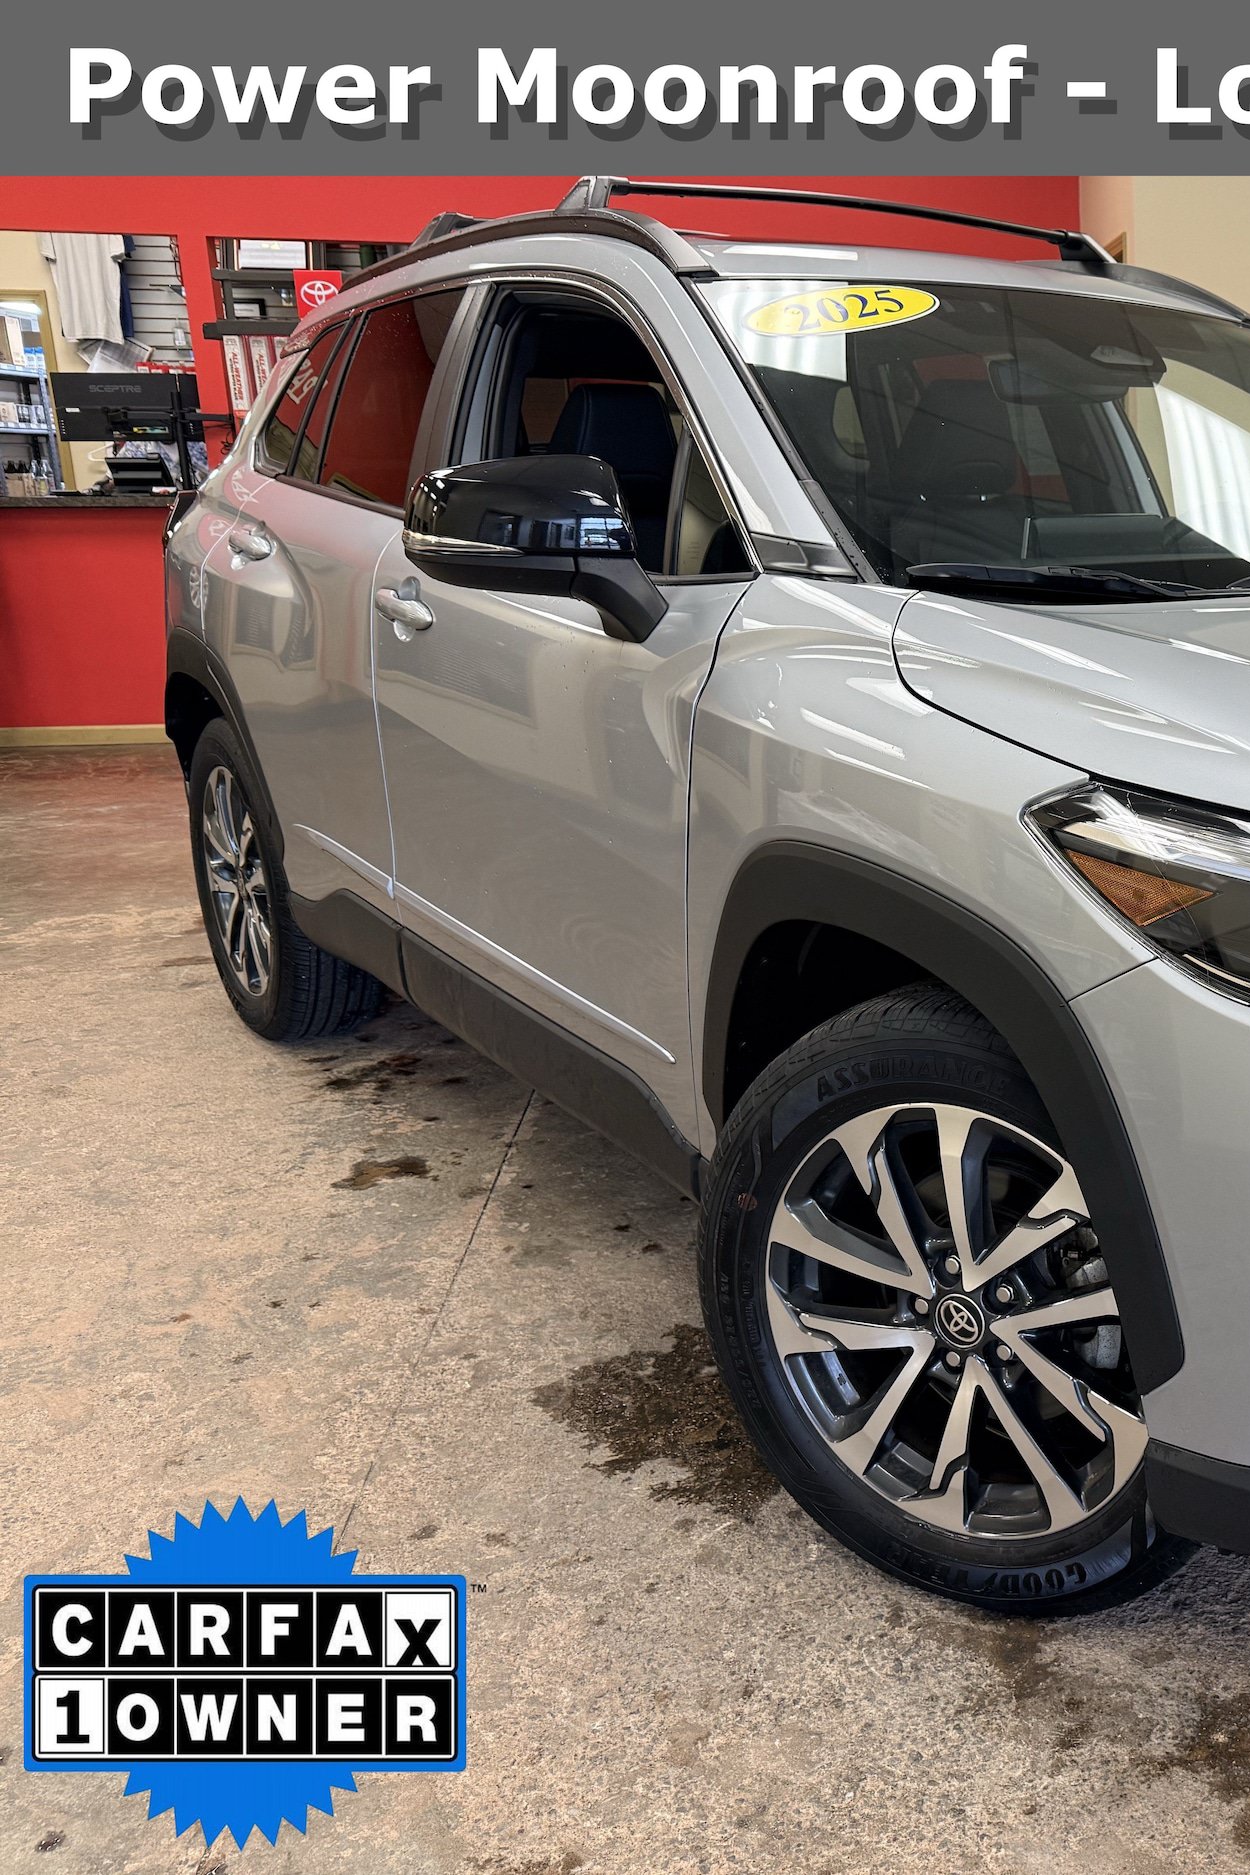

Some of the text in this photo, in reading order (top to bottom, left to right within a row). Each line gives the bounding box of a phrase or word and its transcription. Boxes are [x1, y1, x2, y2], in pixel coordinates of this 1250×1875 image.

[784, 290, 904, 331] 2025
[88, 384, 142, 393] SCEPTRE
[232, 351, 244, 401] ALL-WEATHER
[816, 1053, 1011, 1102] ASSURANCE
